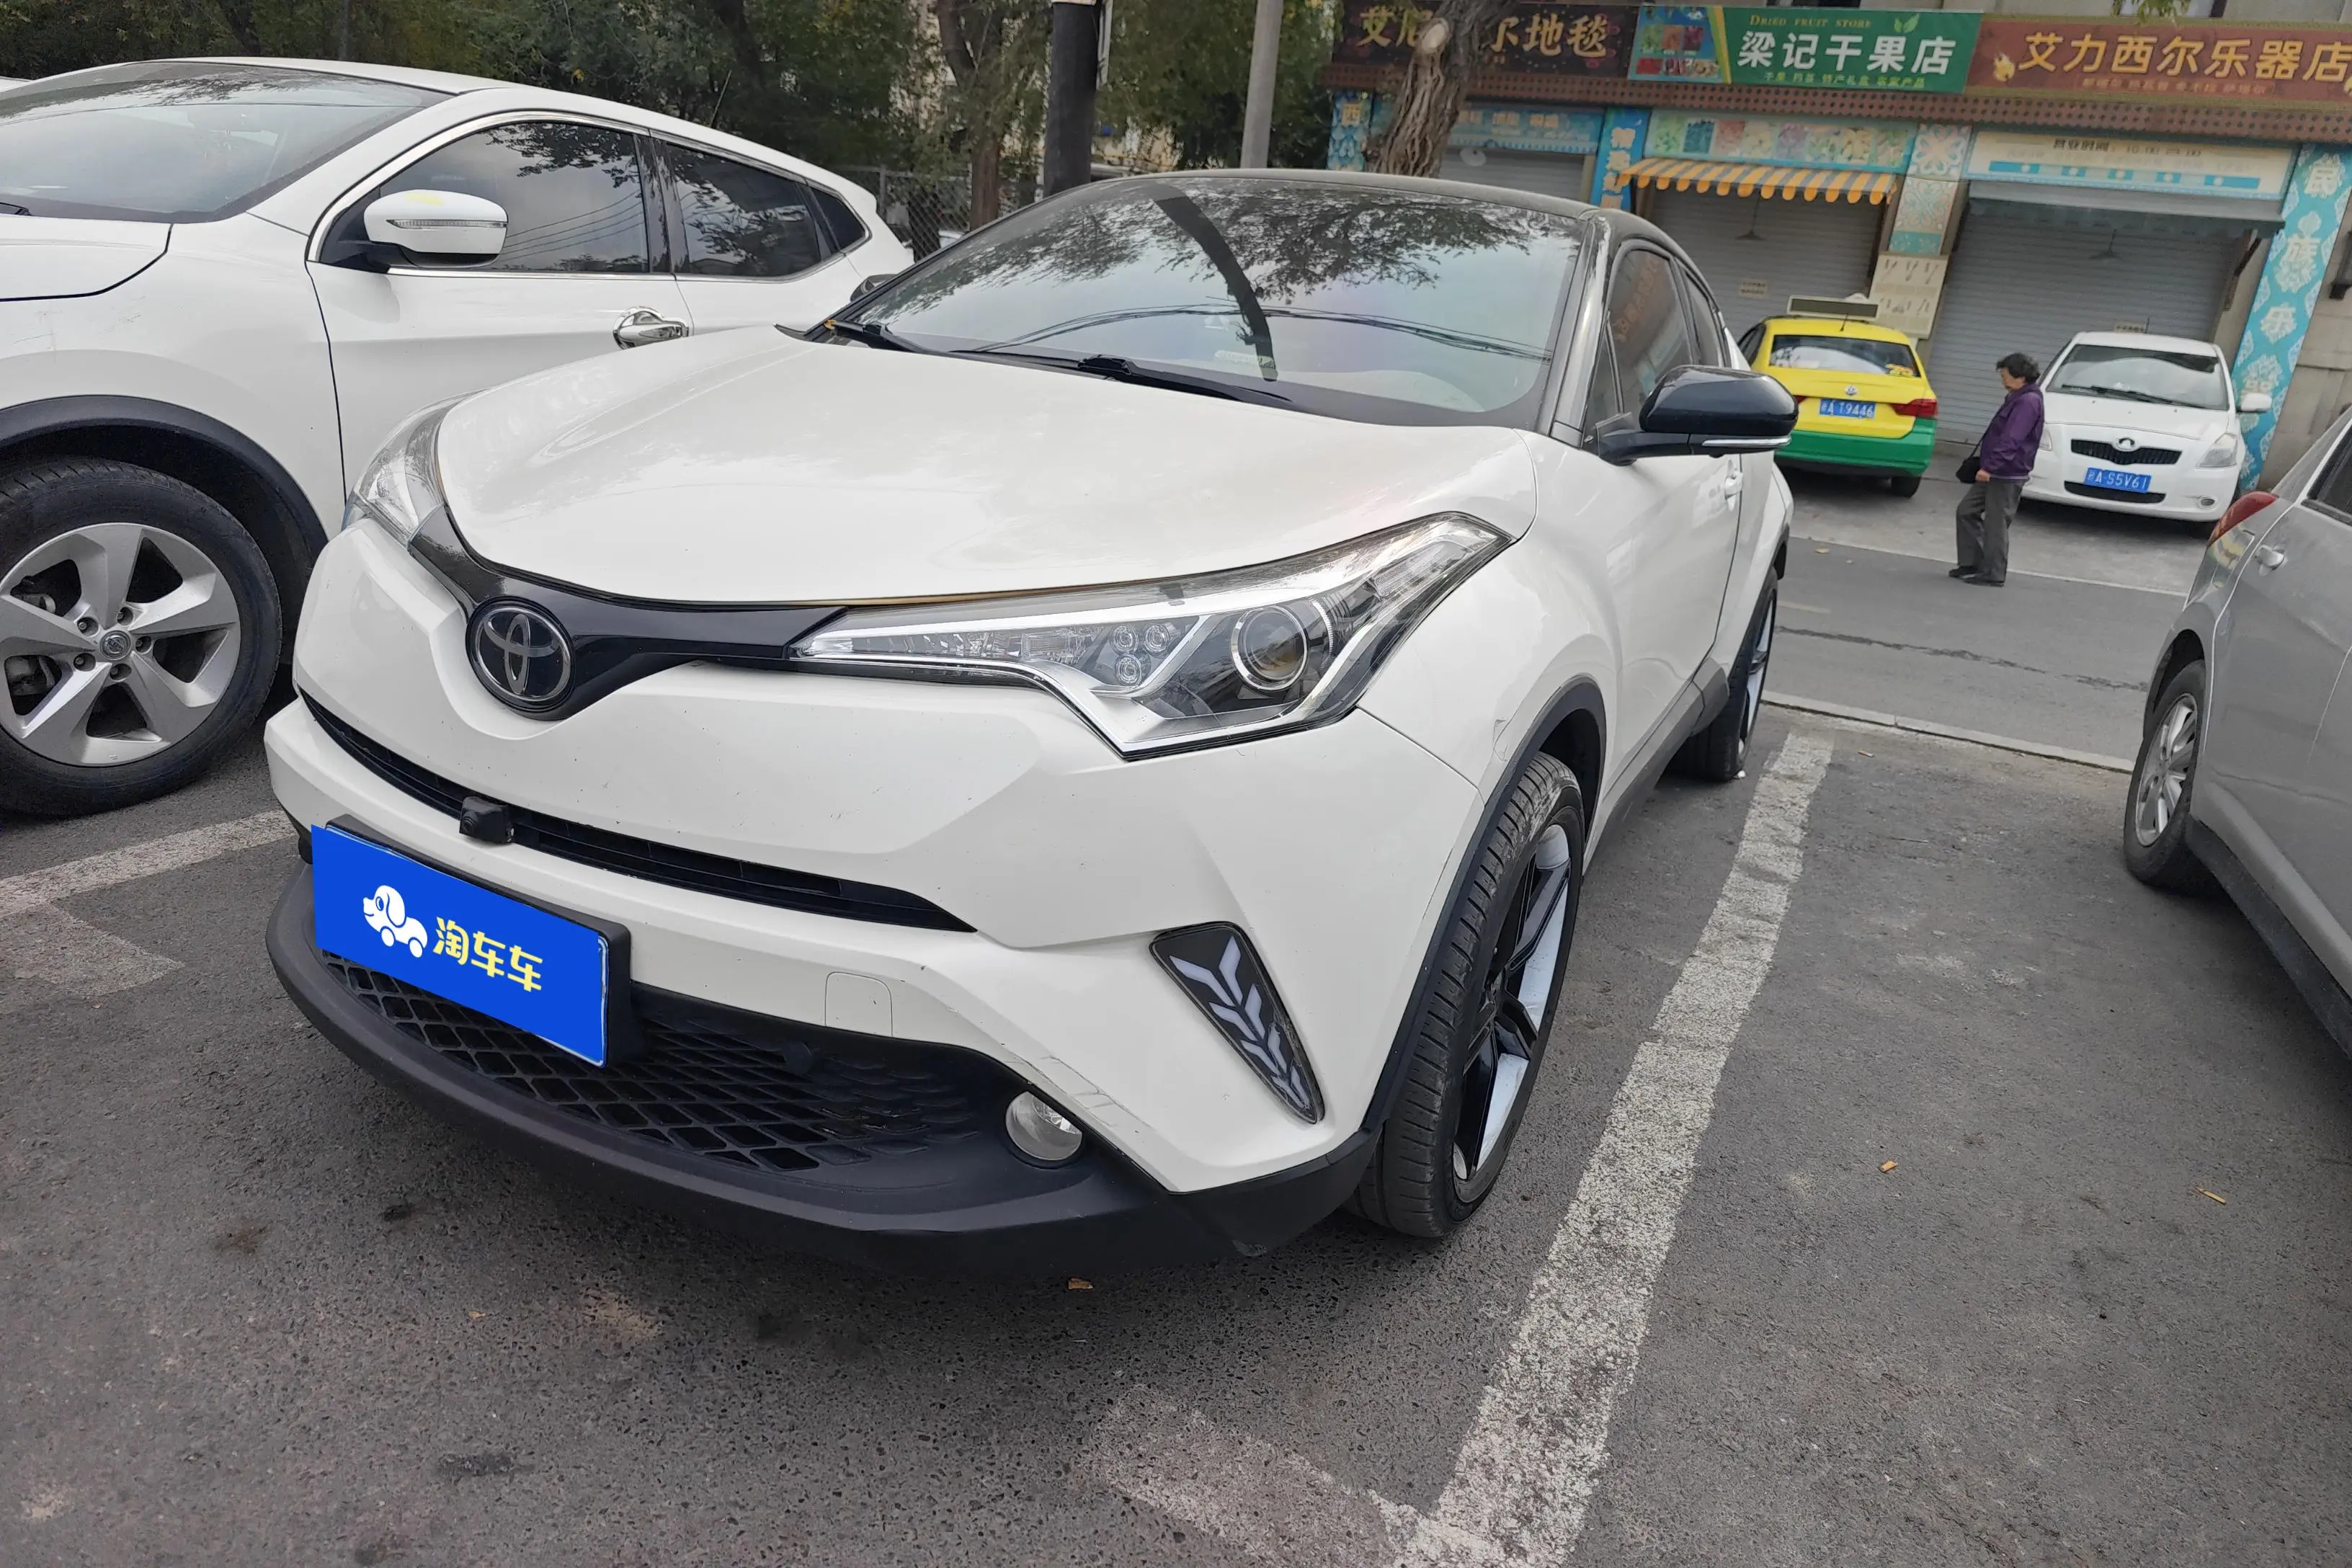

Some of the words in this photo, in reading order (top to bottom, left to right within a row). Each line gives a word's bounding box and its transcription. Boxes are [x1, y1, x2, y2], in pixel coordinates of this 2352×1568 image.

[1737, 30, 1956, 75] 梁记干果店
[2018, 31, 2352, 82] 艾力西尔乐器店
